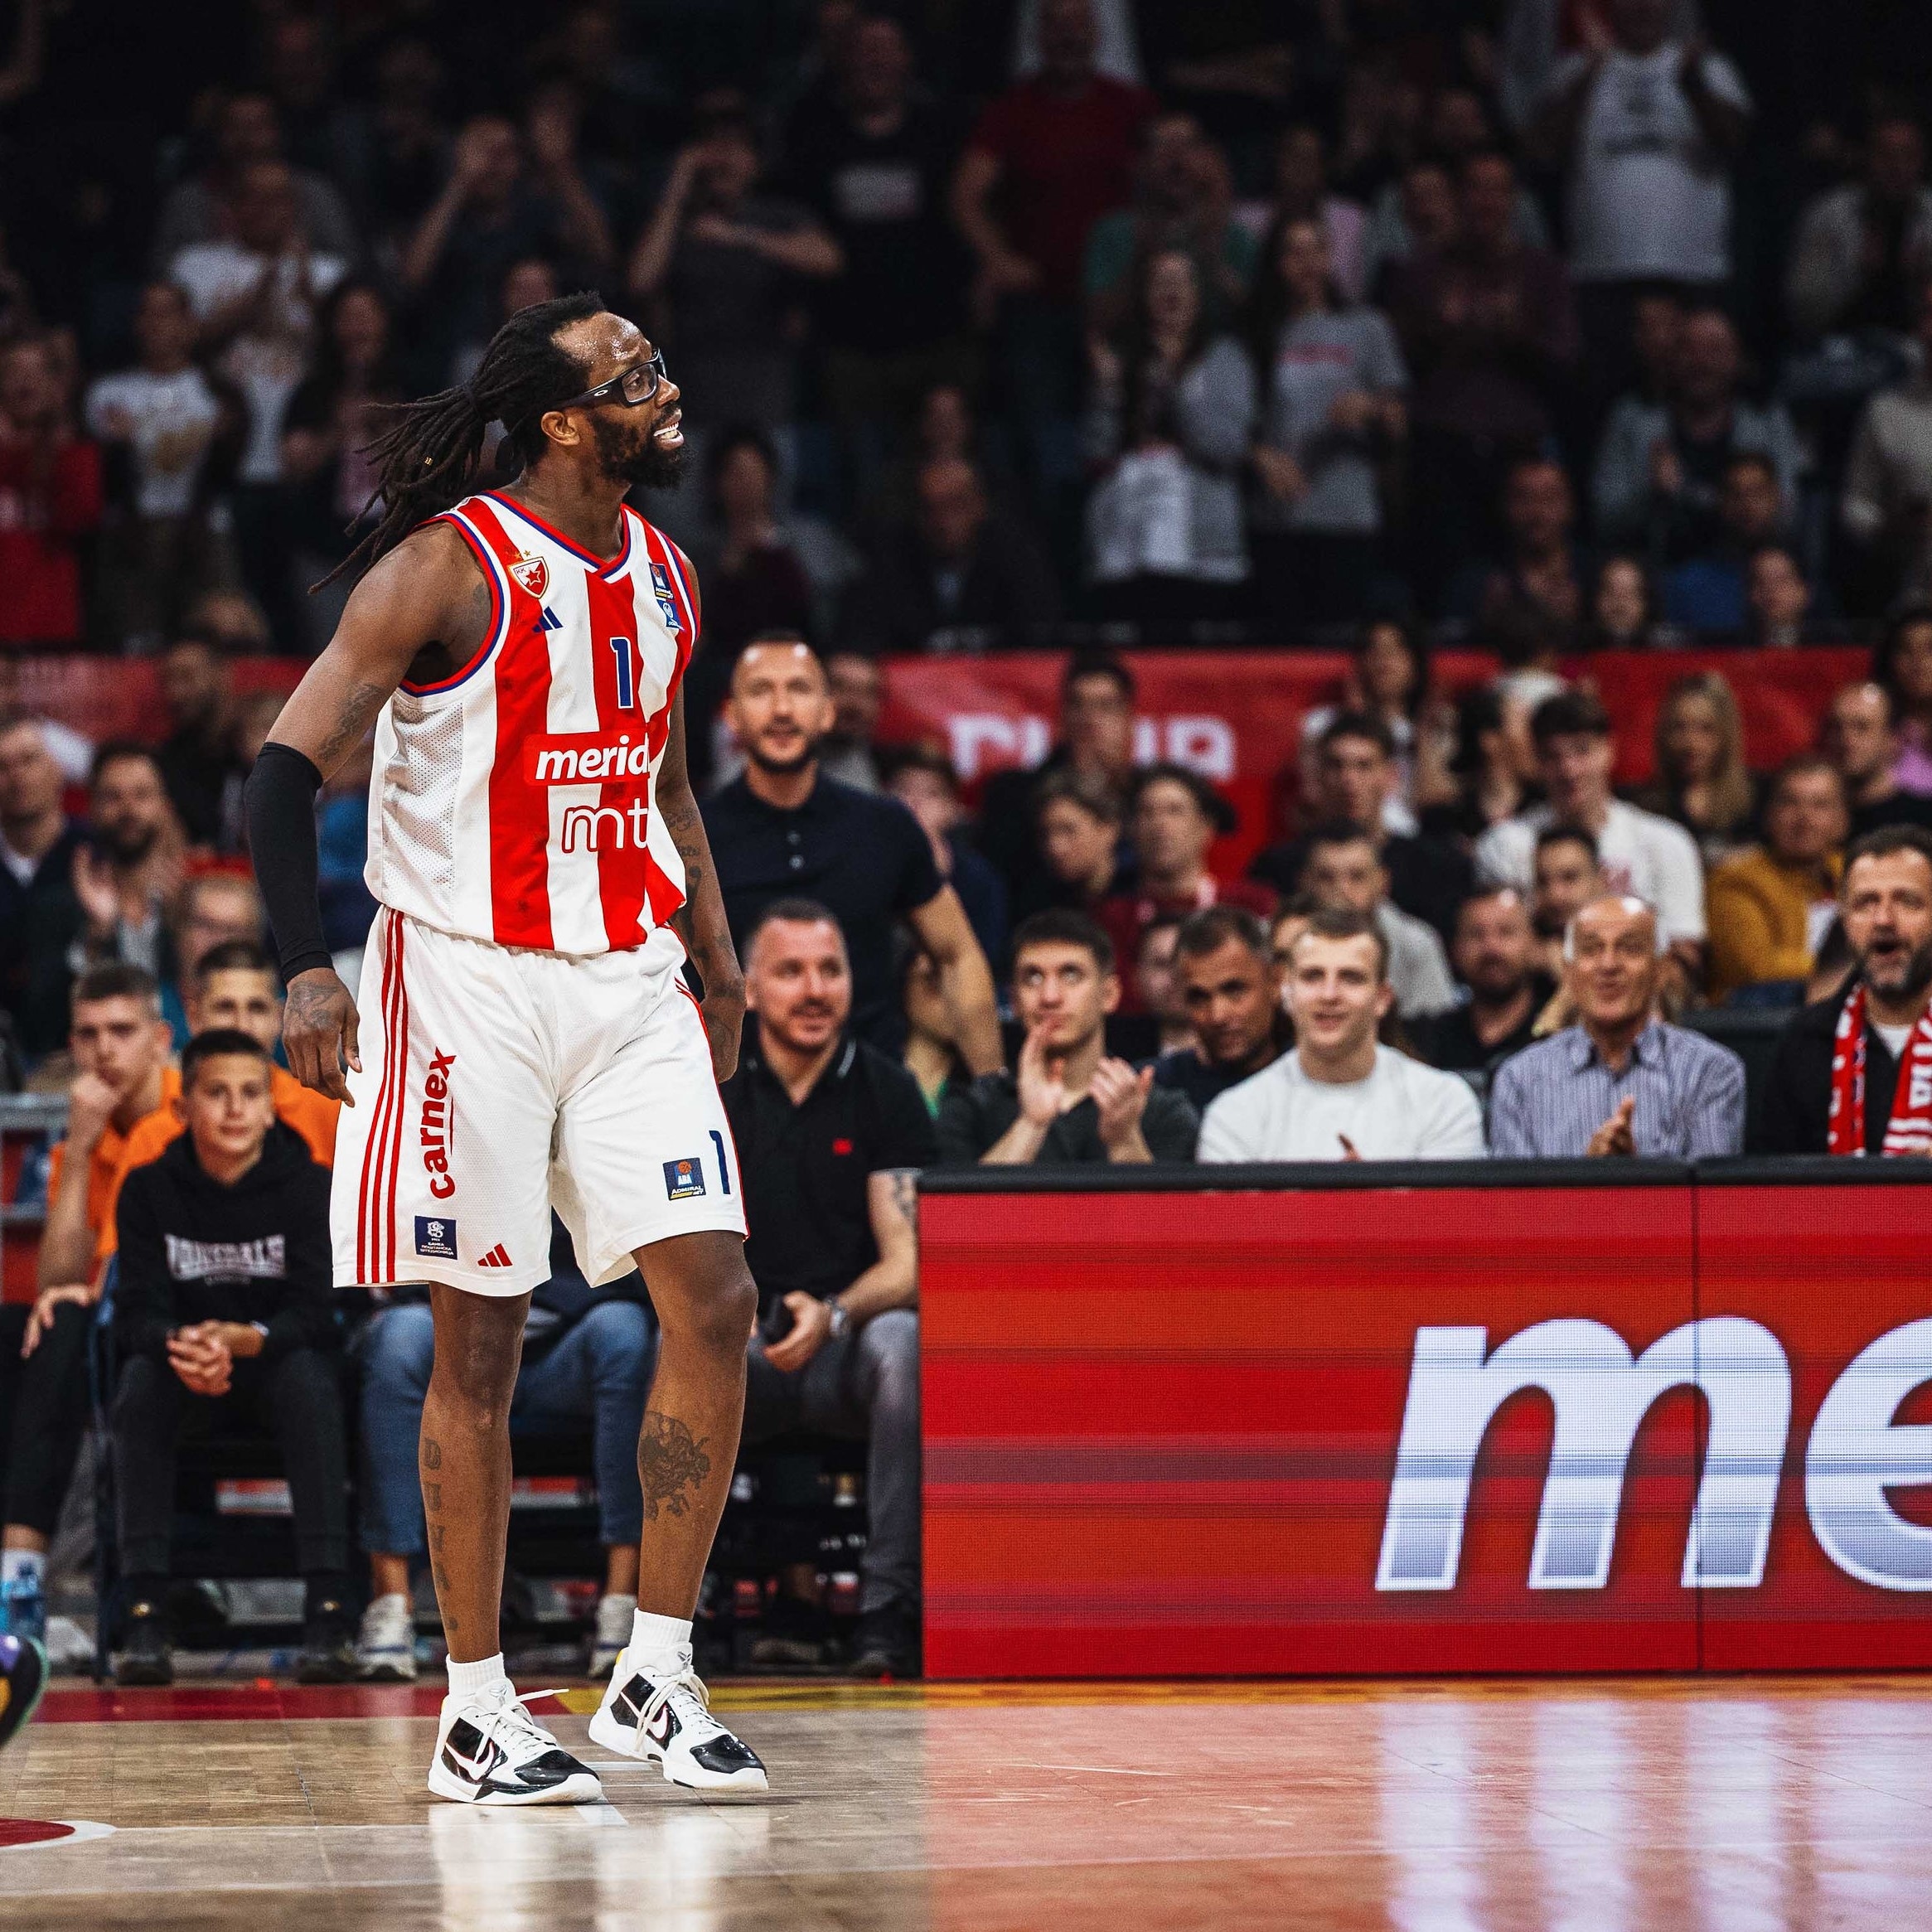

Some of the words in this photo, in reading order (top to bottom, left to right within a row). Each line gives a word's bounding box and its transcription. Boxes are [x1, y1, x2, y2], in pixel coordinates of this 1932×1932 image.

[610, 637, 634, 709] 1
[420, 1047, 457, 1198] carnex
[709, 1131, 730, 1194] 1
